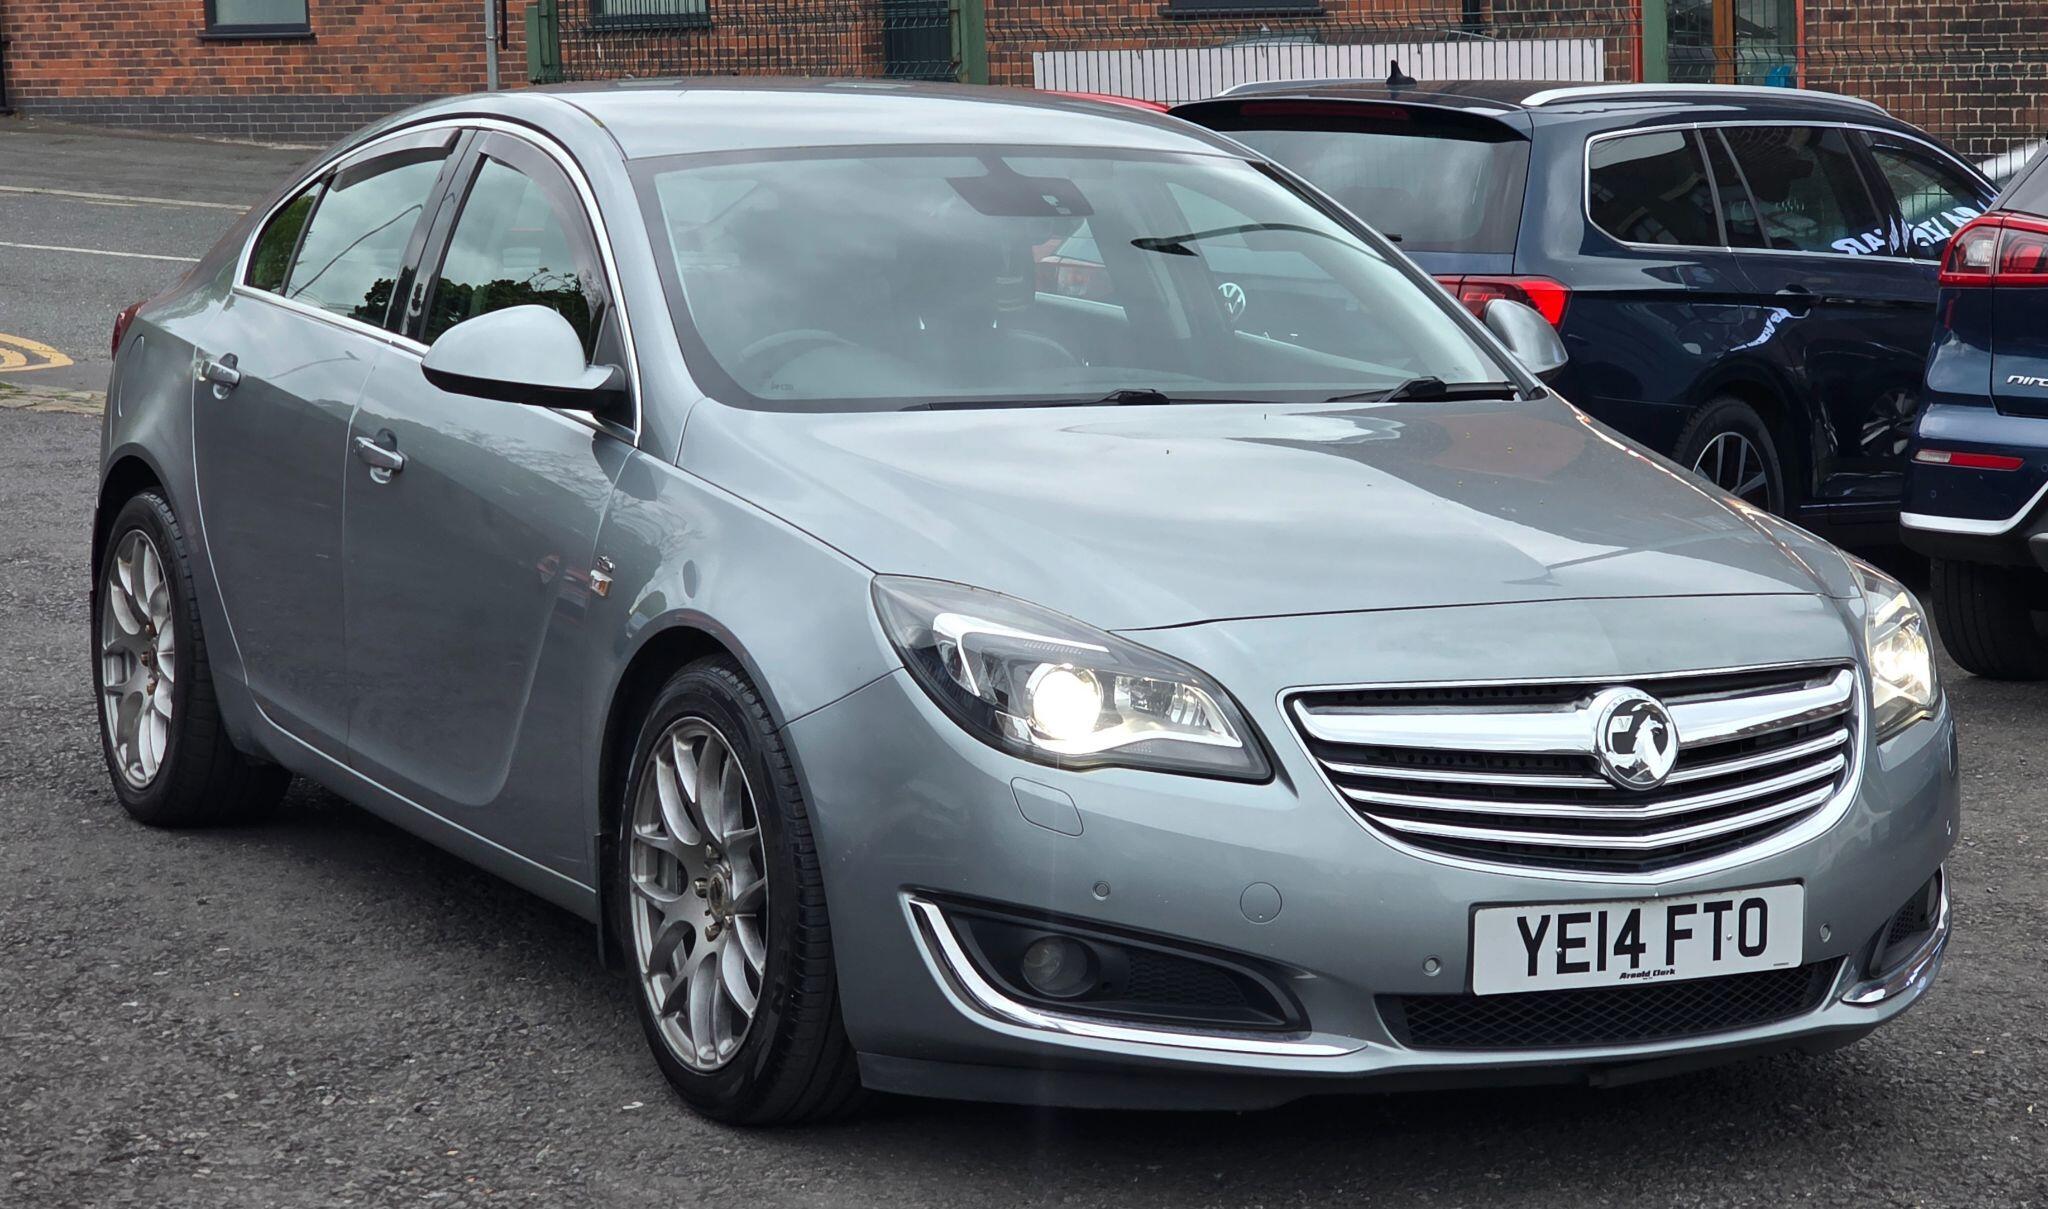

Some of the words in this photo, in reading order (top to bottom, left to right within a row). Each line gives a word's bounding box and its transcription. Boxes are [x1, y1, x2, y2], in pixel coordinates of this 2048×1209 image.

[1516, 908, 1647, 977] YE14
[1665, 897, 1768, 966] FTO
[1619, 971, 1651, 980] Arnold
[1652, 968, 1676, 977] Clark
